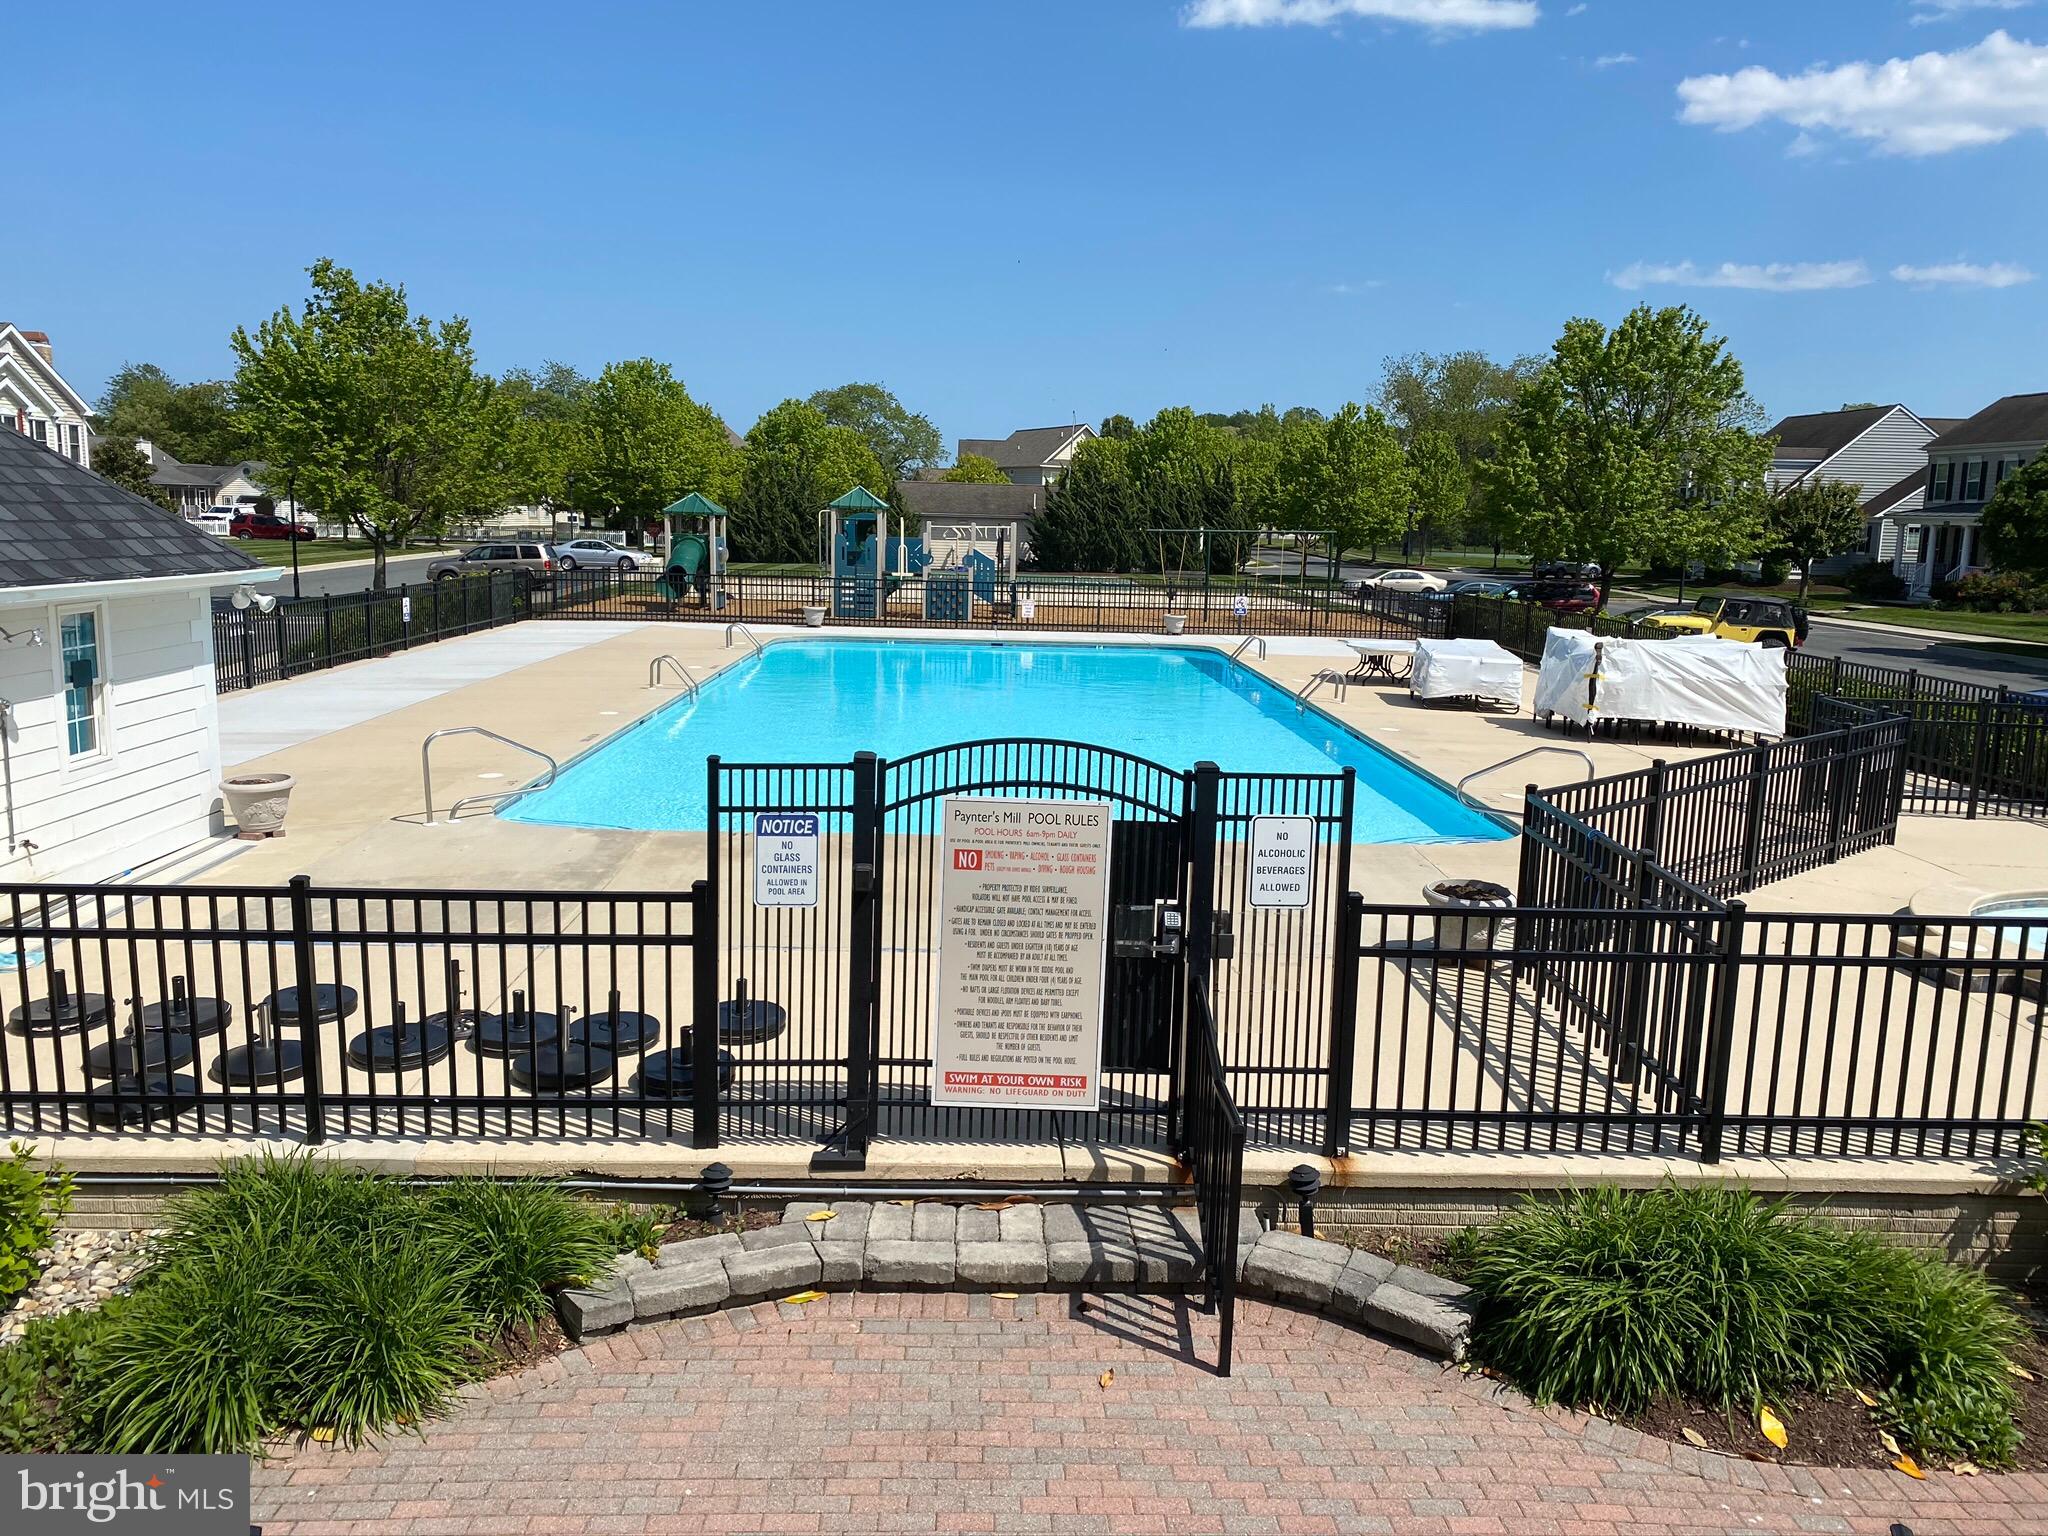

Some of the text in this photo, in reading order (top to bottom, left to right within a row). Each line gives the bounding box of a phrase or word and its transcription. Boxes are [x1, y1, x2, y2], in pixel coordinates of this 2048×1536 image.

[954, 809, 1098, 826] Paynter's Mill POOL RULES
[761, 820, 814, 834] NOTICE
[974, 827, 1077, 839] POOL HOURS 6am-9pm DAILY
[1276, 832, 1289, 841] NO
[781, 840, 793, 850] NO
[773, 853, 801, 862] GLASS
[1056, 852, 1069, 861] GLASS
[1257, 849, 1306, 858] ALCOHOLIC
[958, 850, 977, 868] NO
[761, 865, 813, 874] CONTAINERS
[1256, 866, 1306, 875] BEVERAGES
[1259, 883, 1300, 892] ALLOWED
[1006, 919, 1015, 927] AND
[980, 1054, 989, 1062] AND
[1052, 1056, 1063, 1064] POOL
[949, 1073, 1082, 1086] SWIM AT YOUR OWN RISK
[944, 1085, 1086, 1097] WARNING: NO LIFEGUARD ON DUTY
